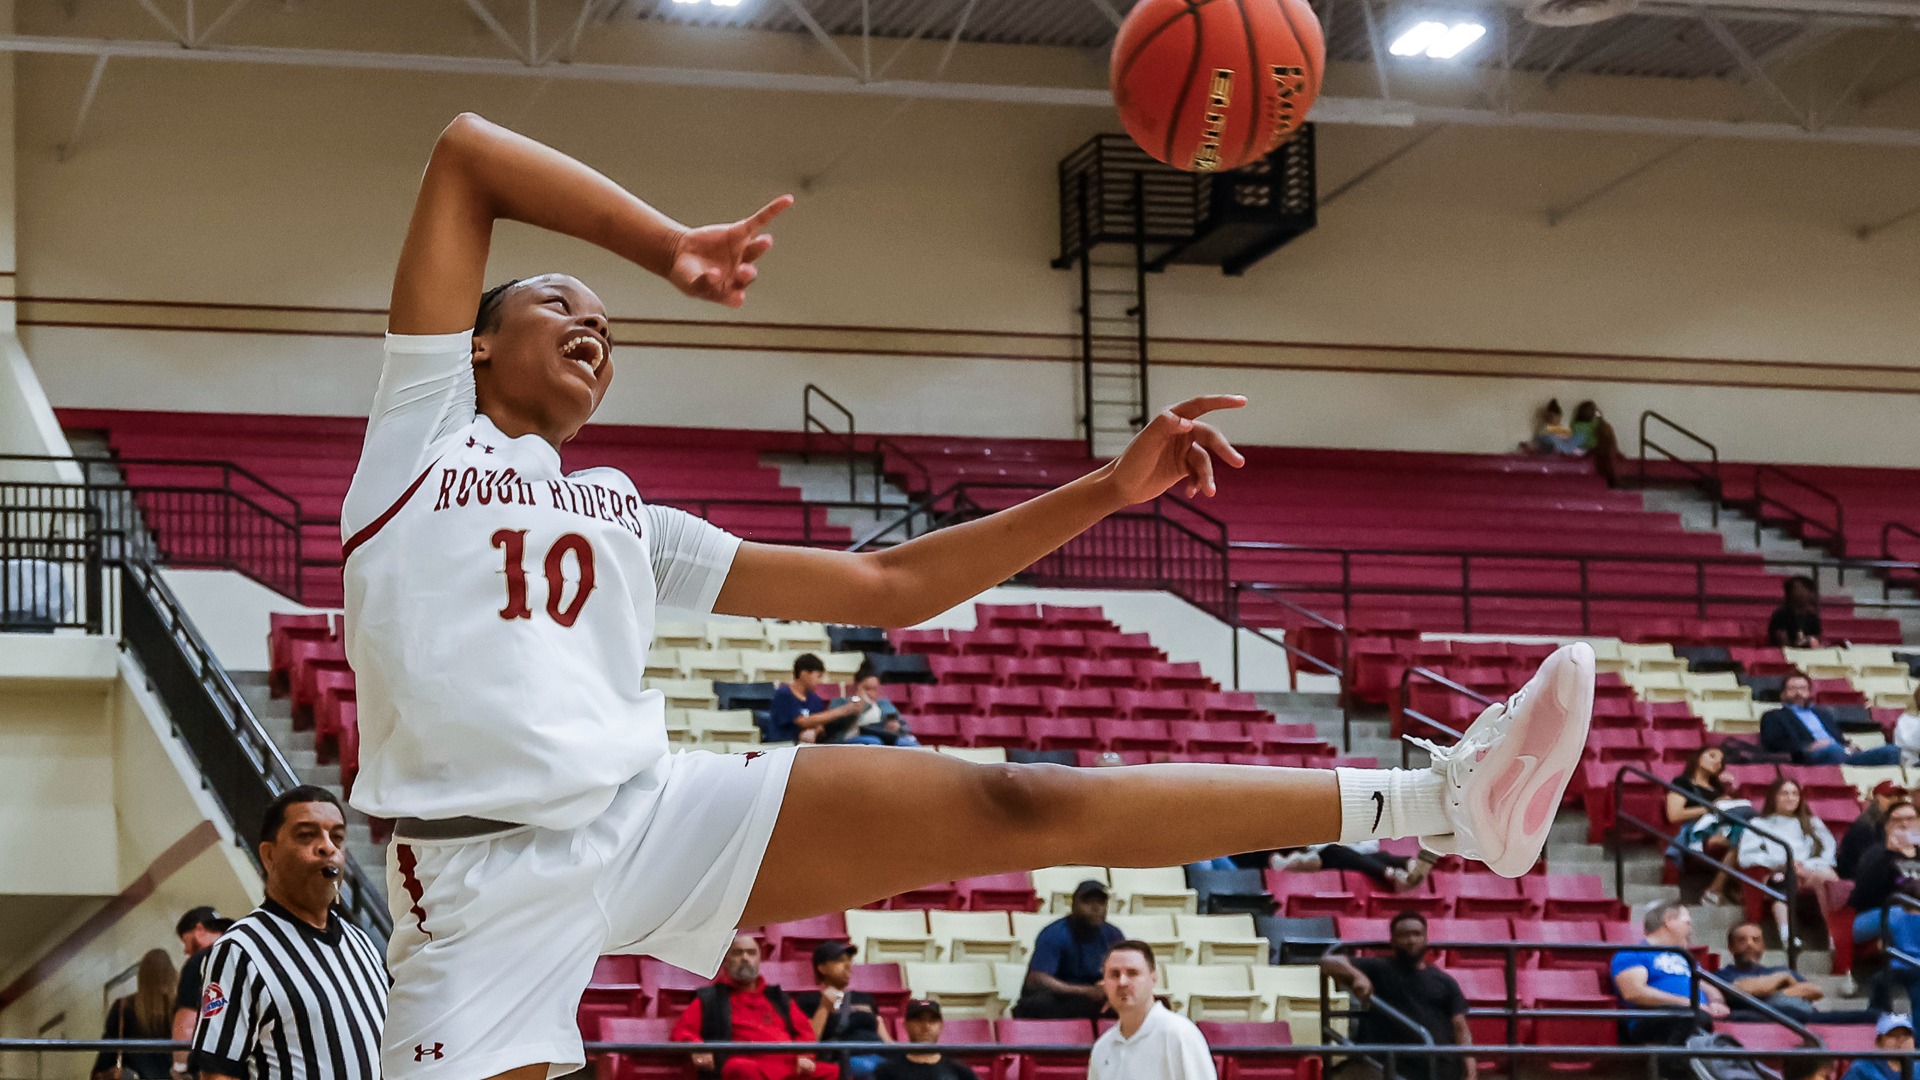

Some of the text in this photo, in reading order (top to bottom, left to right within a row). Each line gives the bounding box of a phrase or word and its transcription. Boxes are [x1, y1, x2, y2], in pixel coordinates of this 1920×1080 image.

[434, 467, 642, 539] ROUGH RIDERS
[490, 527, 597, 629] 10
